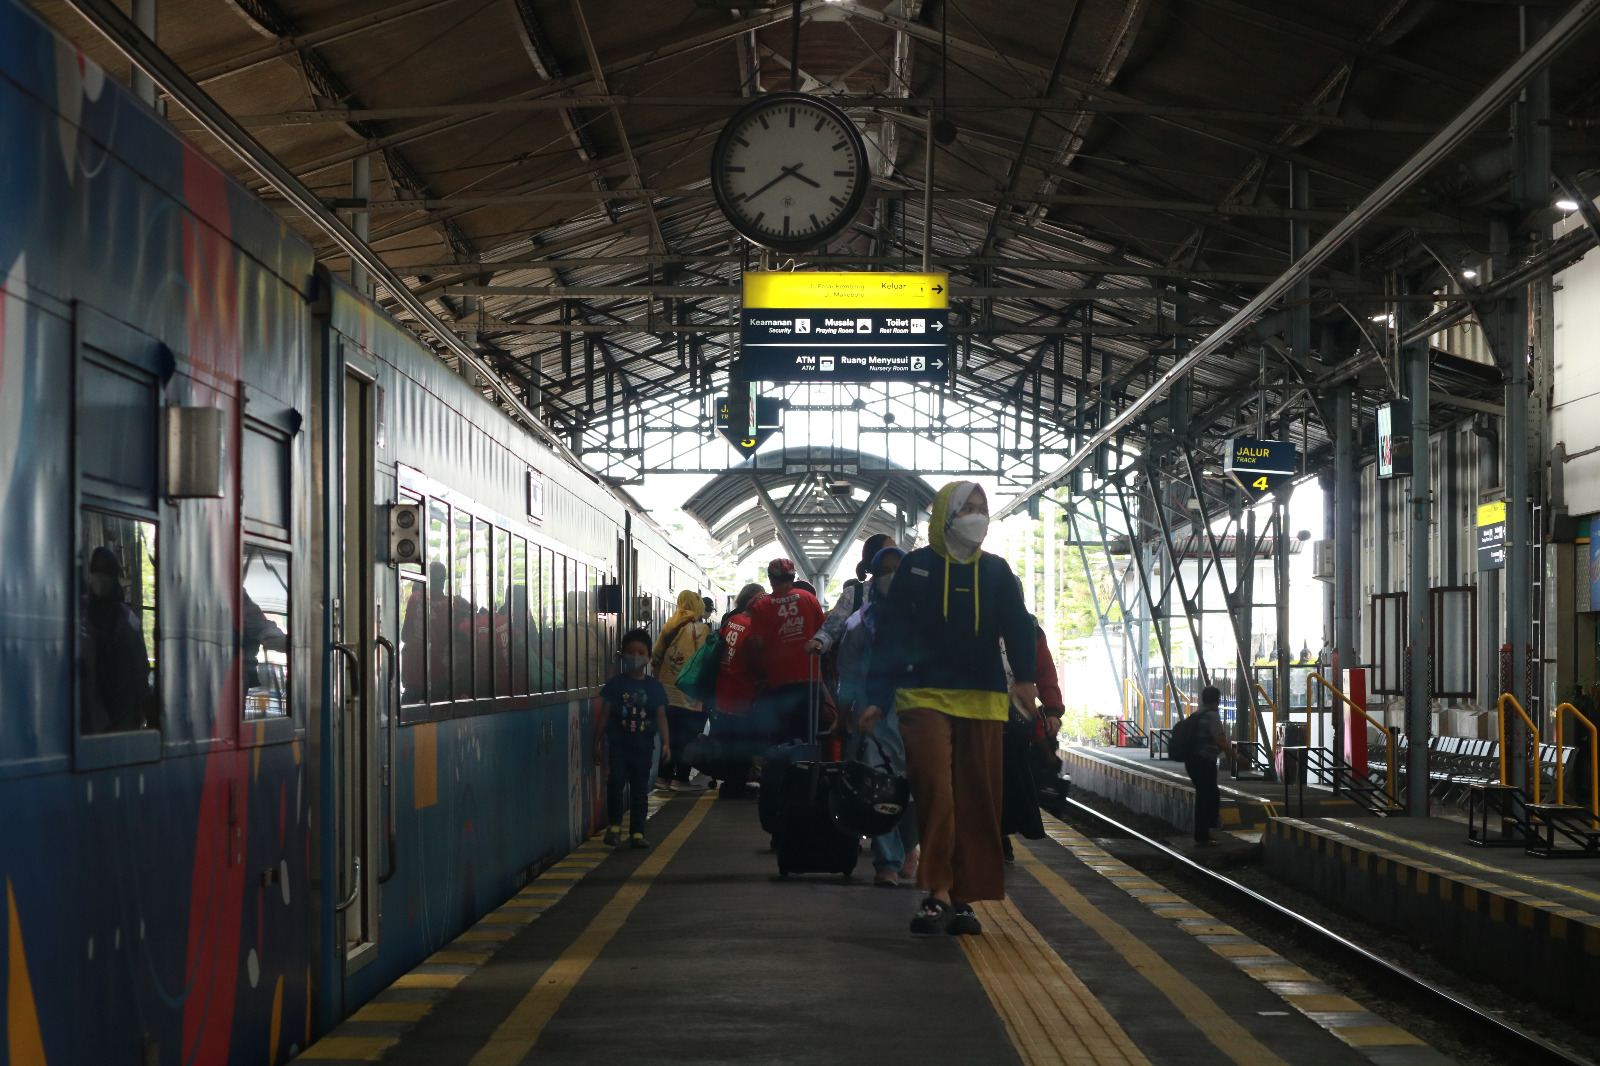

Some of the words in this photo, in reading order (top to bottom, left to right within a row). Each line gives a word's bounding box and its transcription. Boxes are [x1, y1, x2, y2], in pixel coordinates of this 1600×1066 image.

[881, 282, 907, 291] Keluar
[749, 318, 792, 327] Keamanan
[885, 318, 909, 327] Toilet
[768, 327, 792, 335] Security
[815, 327, 838, 335] Praying
[795, 356, 816, 364] ATM
[841, 356, 867, 366] Ruang
[868, 356, 909, 366] Menyusui
[1236, 447, 1270, 457] JALUR
[1253, 477, 1268, 490] 4
[771, 594, 800, 604] PORTER
[778, 602, 798, 618] 45
[728, 621, 745, 632] PORTER
[787, 616, 804, 627] KAI
[726, 631, 738, 646] 49
